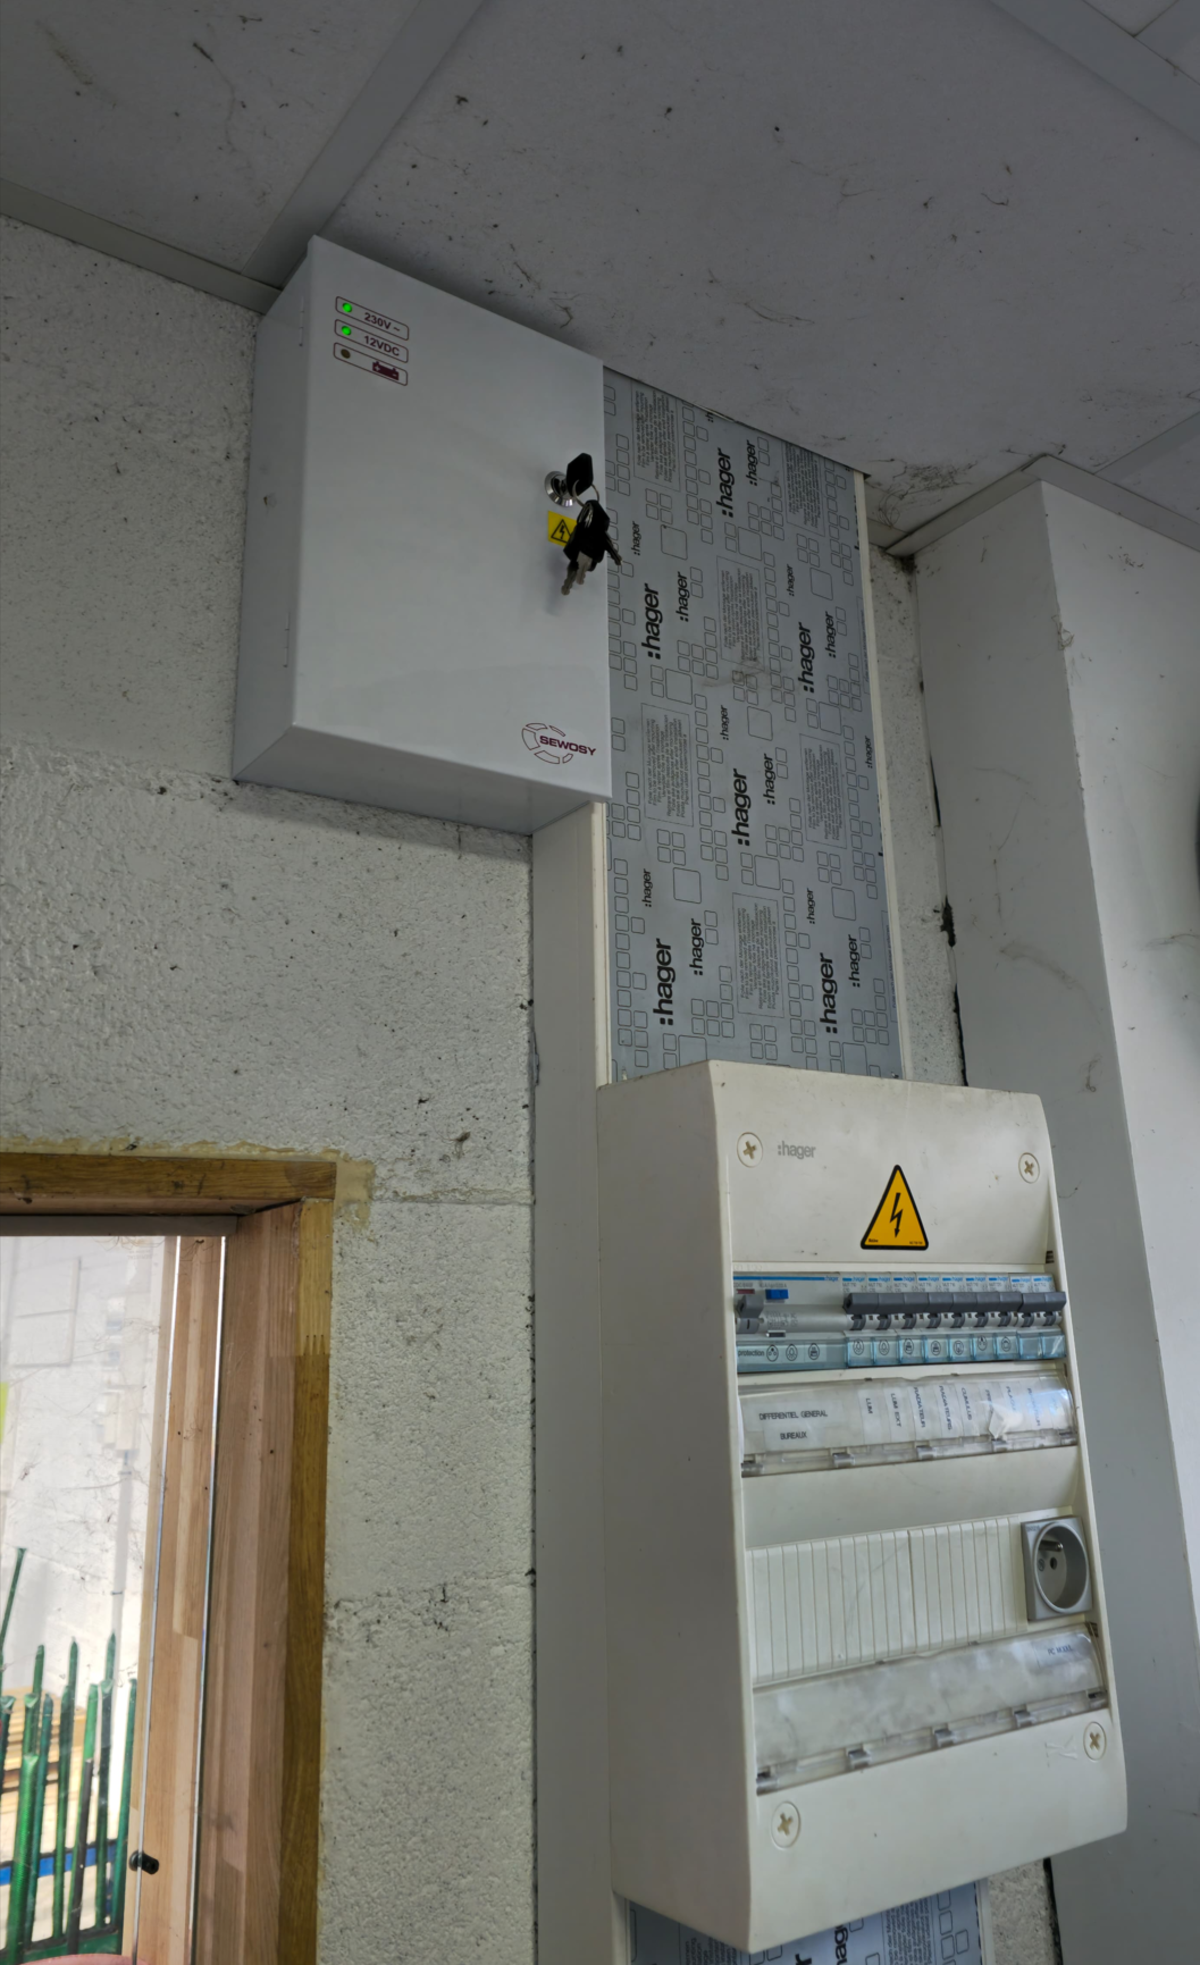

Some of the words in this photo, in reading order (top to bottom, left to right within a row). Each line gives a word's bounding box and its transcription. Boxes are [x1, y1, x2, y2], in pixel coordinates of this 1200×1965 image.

[364, 312, 392, 329] 230V
[364, 335, 400, 356] 12VDC
[540, 735, 596, 756] SEWOSY
[777, 1140, 816, 1160] :hager
[866, 1398, 874, 1414] LUM
[890, 1393, 898, 1409] LUM
[914, 1386, 926, 1428] RADIATEUR
[759, 1411, 798, 1421] DIFFERENTIEL
[800, 1410, 828, 1418] GENERAL
[780, 1431, 807, 1440] BUREAUX
